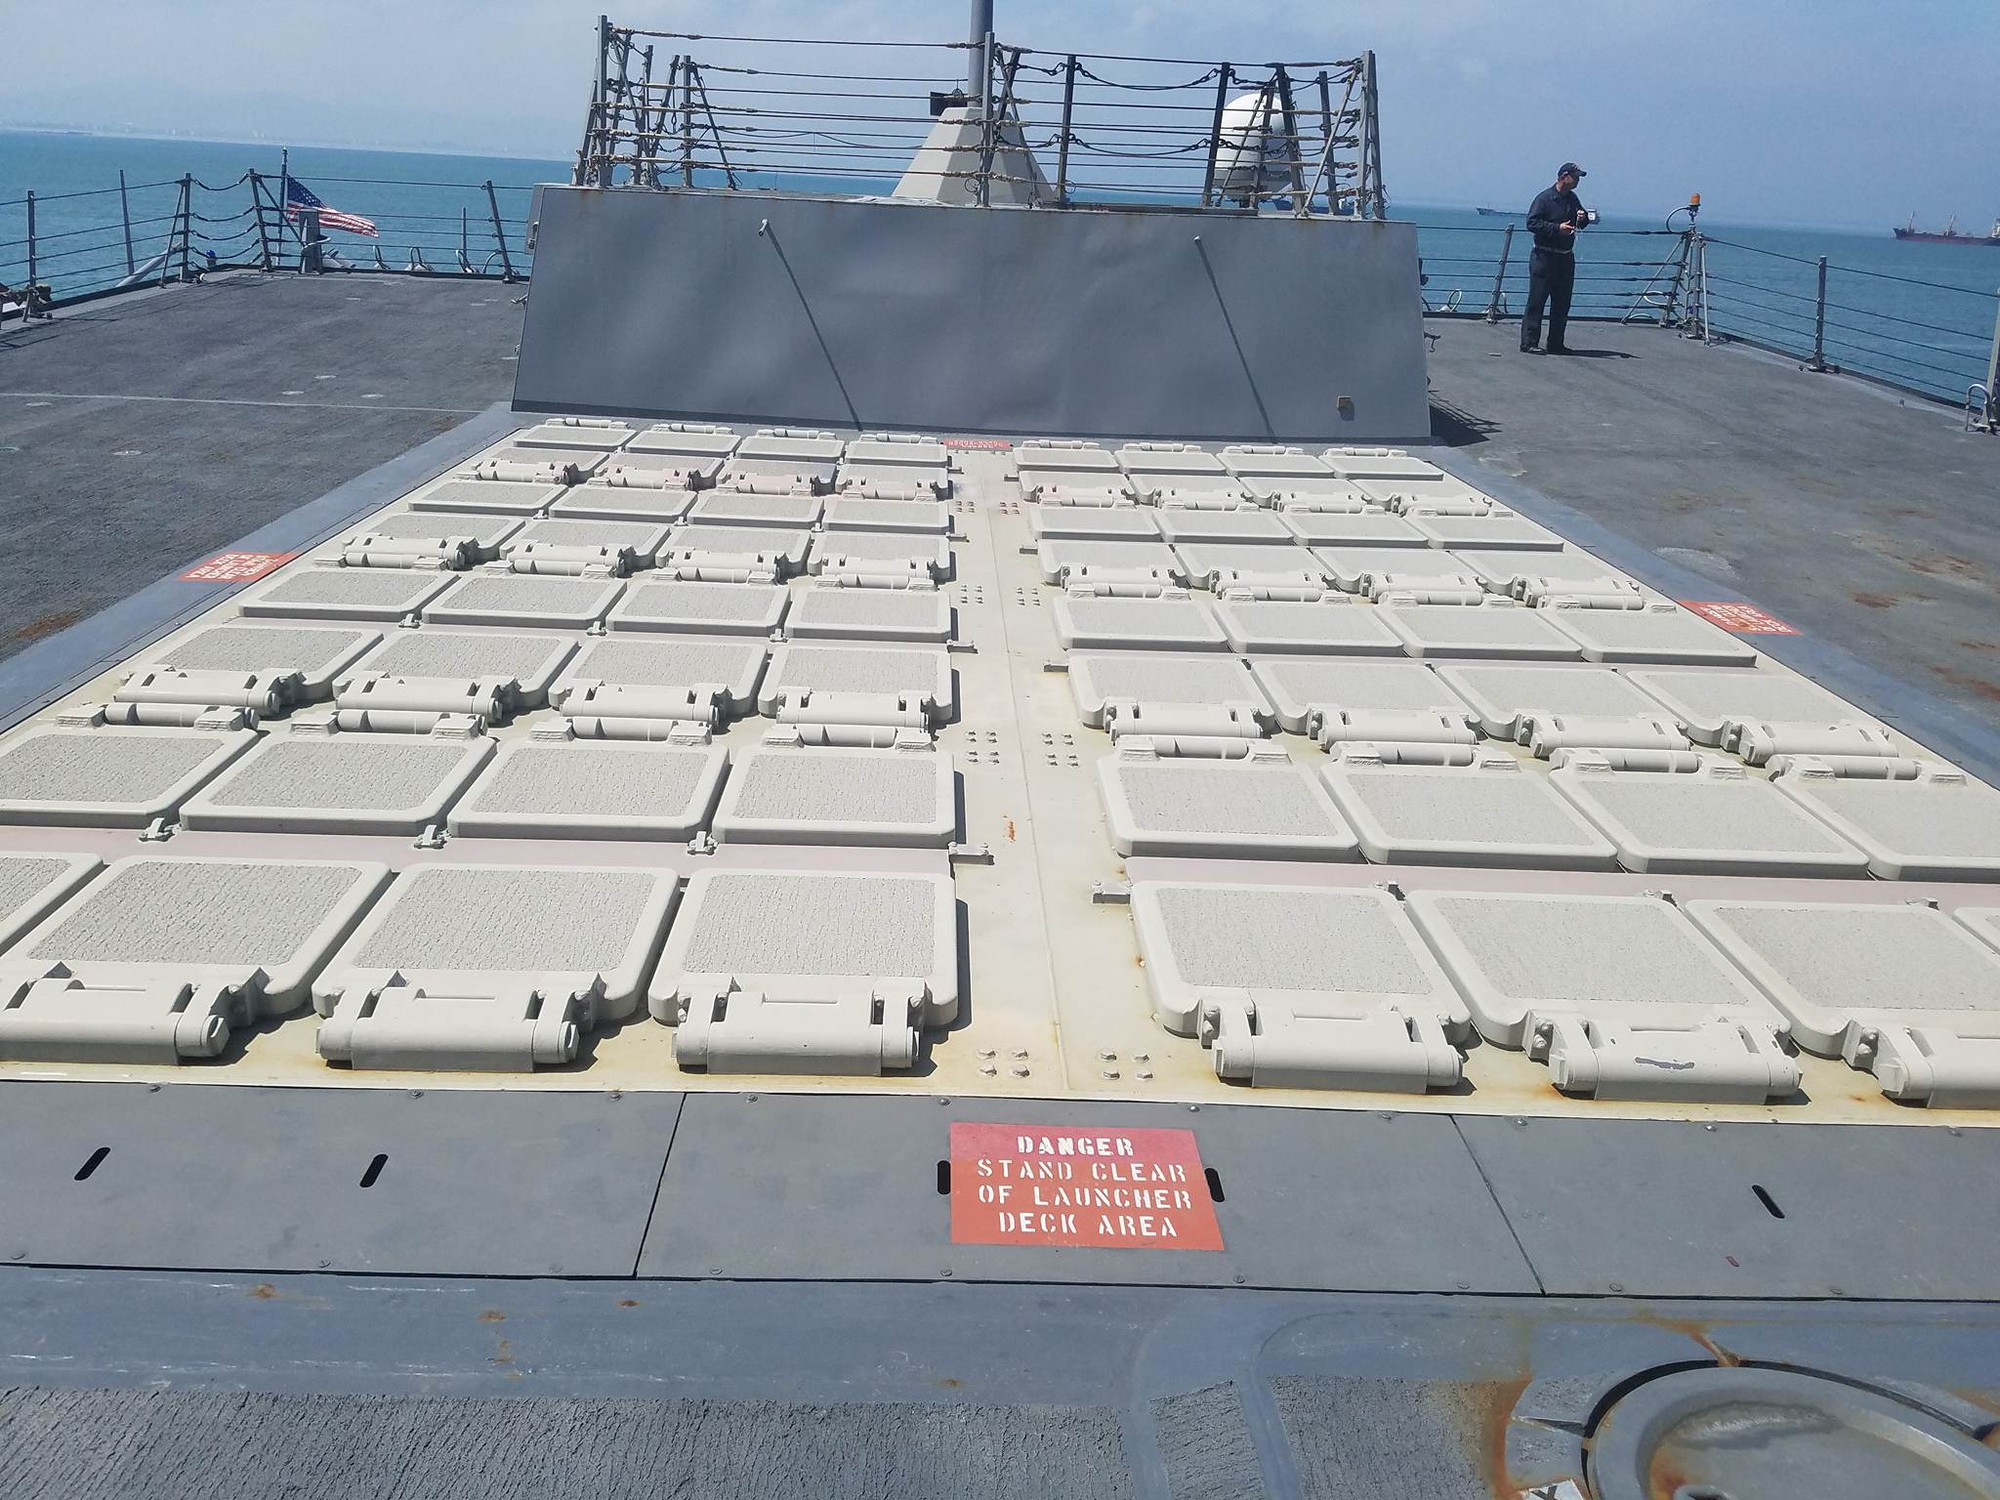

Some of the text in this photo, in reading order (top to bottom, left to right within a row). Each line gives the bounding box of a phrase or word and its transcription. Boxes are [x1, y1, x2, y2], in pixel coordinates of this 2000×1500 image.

[1017, 1136, 1134, 1156] DANGER
[977, 1158, 1186, 1183] STAND CLEAR
[978, 1185, 1192, 1210] OF LAUNCHER
[998, 1212, 1178, 1237] DECK AREA
